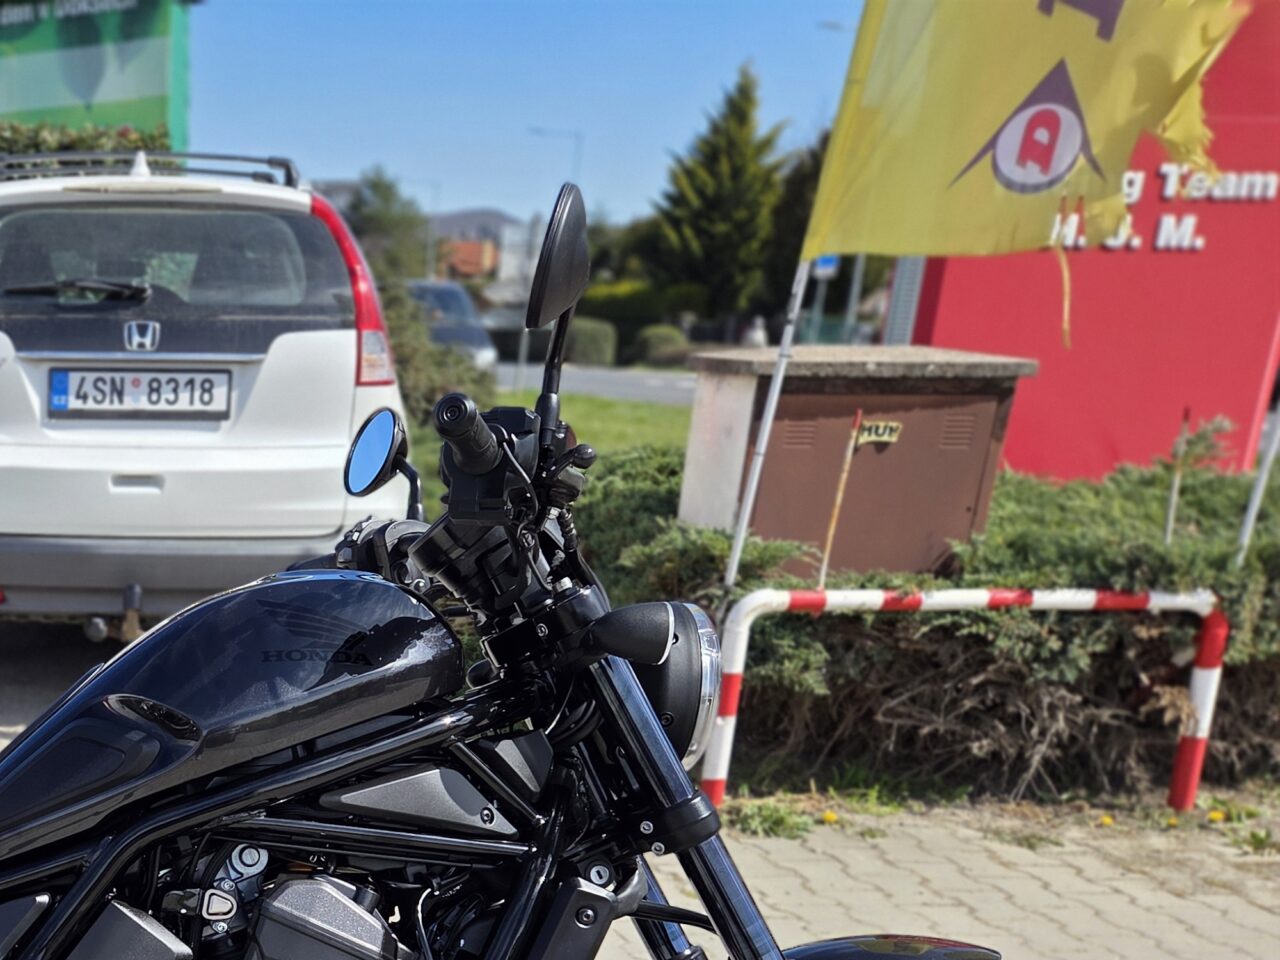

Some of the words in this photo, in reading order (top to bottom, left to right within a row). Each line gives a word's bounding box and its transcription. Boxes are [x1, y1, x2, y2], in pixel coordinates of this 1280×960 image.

[1160, 163, 1279, 199] Team
[1155, 213, 1205, 249] M.
[75, 376, 125, 405] 4SN
[147, 376, 215, 406] 8318
[262, 649, 375, 666] HONDA
